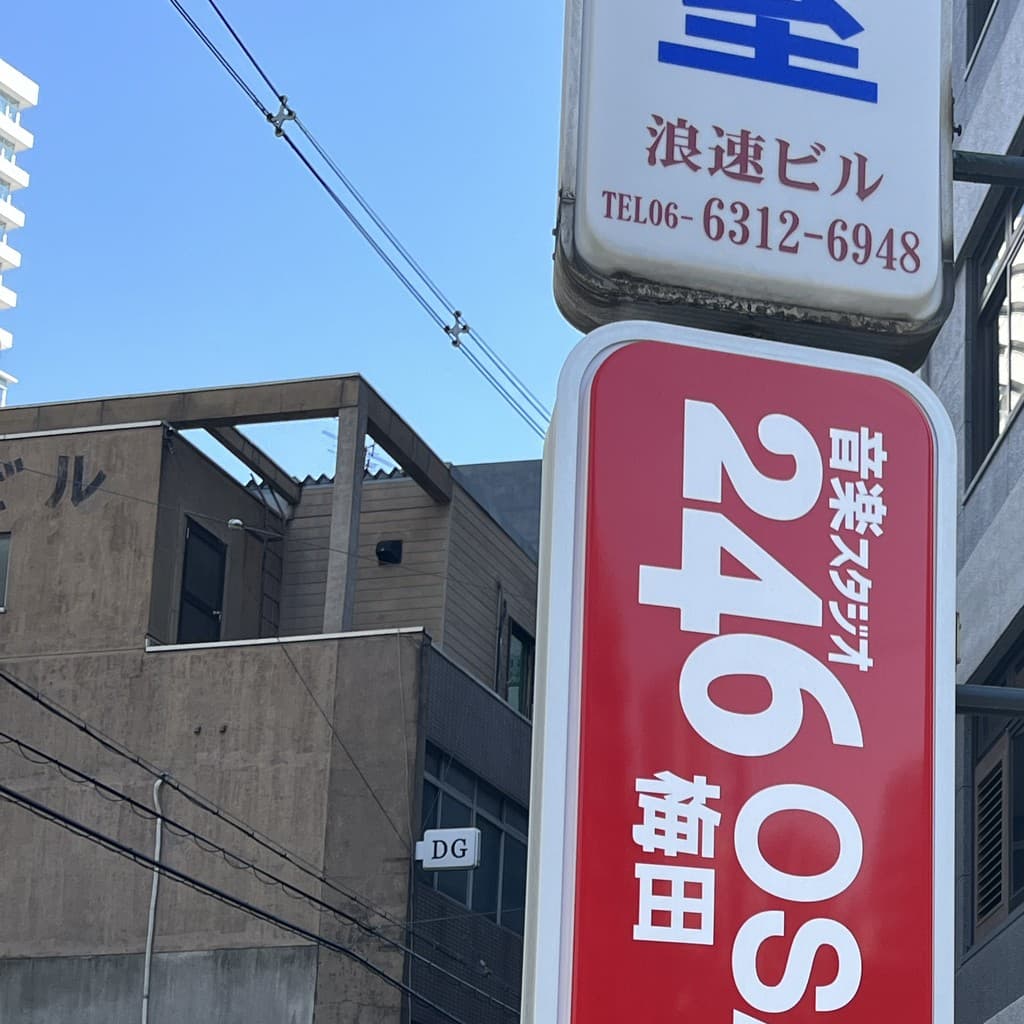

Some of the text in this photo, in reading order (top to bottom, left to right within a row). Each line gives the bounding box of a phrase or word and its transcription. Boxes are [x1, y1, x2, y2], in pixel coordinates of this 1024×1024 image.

[645, 113, 884, 203] 浪速ビル
[638, 398, 864, 757] 246
[828, 427, 888, 672] 音楽スタジオ
[431, 837, 468, 860] DG
[632, 769, 722, 945] 梅田
